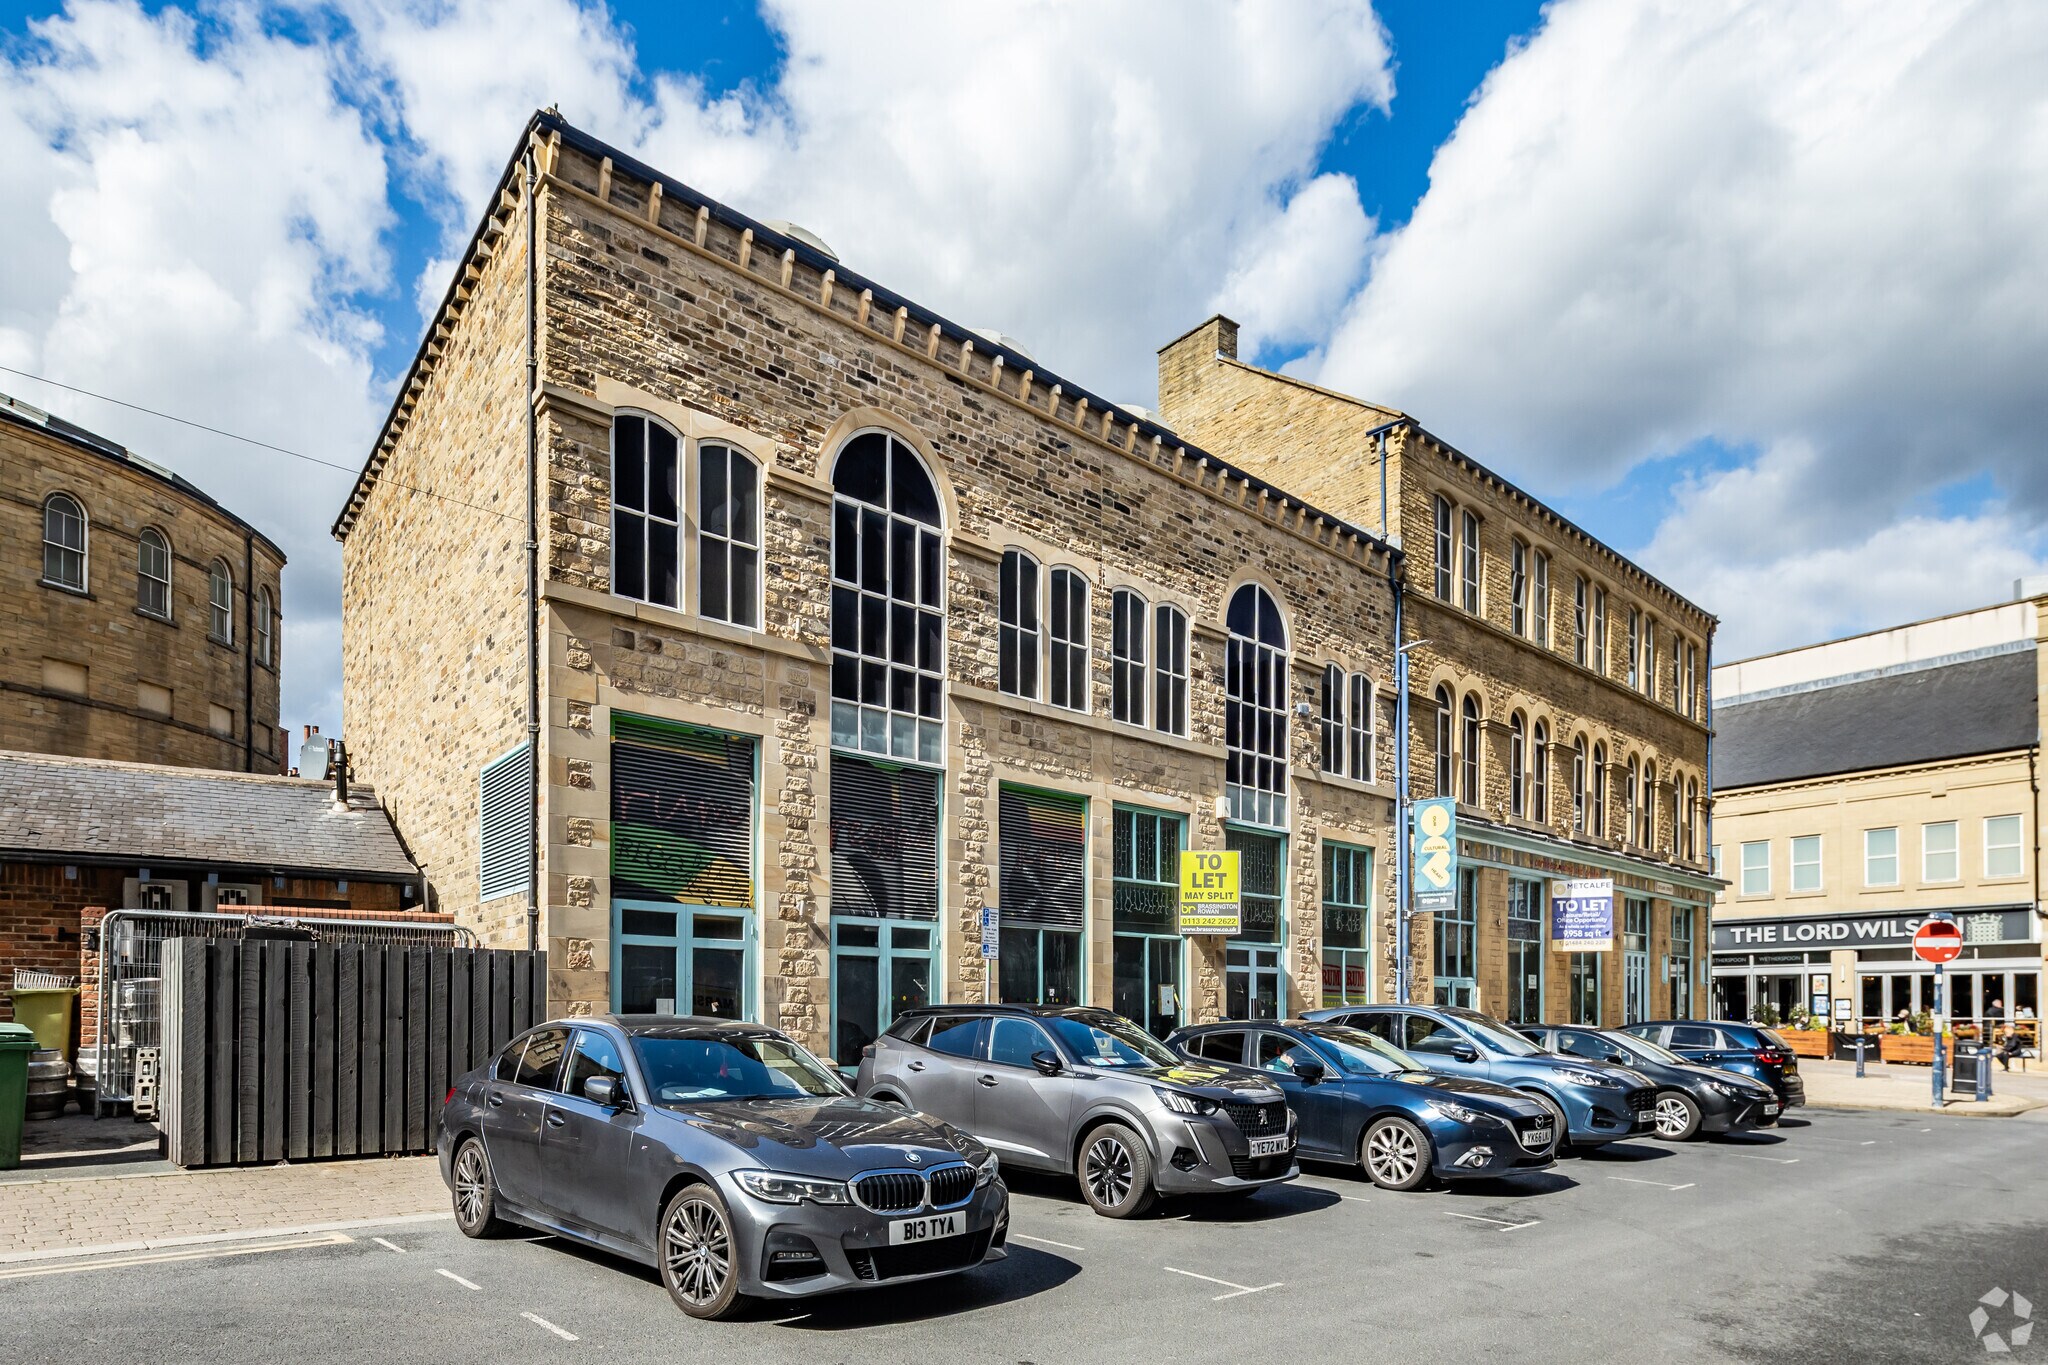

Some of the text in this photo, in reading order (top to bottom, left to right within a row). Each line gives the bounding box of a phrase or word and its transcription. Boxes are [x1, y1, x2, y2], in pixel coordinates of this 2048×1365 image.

[1196, 854, 1222, 870] TO
[1192, 873, 1227, 888] LET
[1431, 867, 1444, 880] HEART
[1557, 899, 1608, 911] TO LET
[1563, 929, 1602, 939] 9,958 sq ft
[1730, 917, 1964, 944] THE LORD WILS
[1346, 970, 1365, 987] RUM
[1257, 1141, 1274, 1154] YE72
[903, 1216, 955, 1240] B13 TYA
